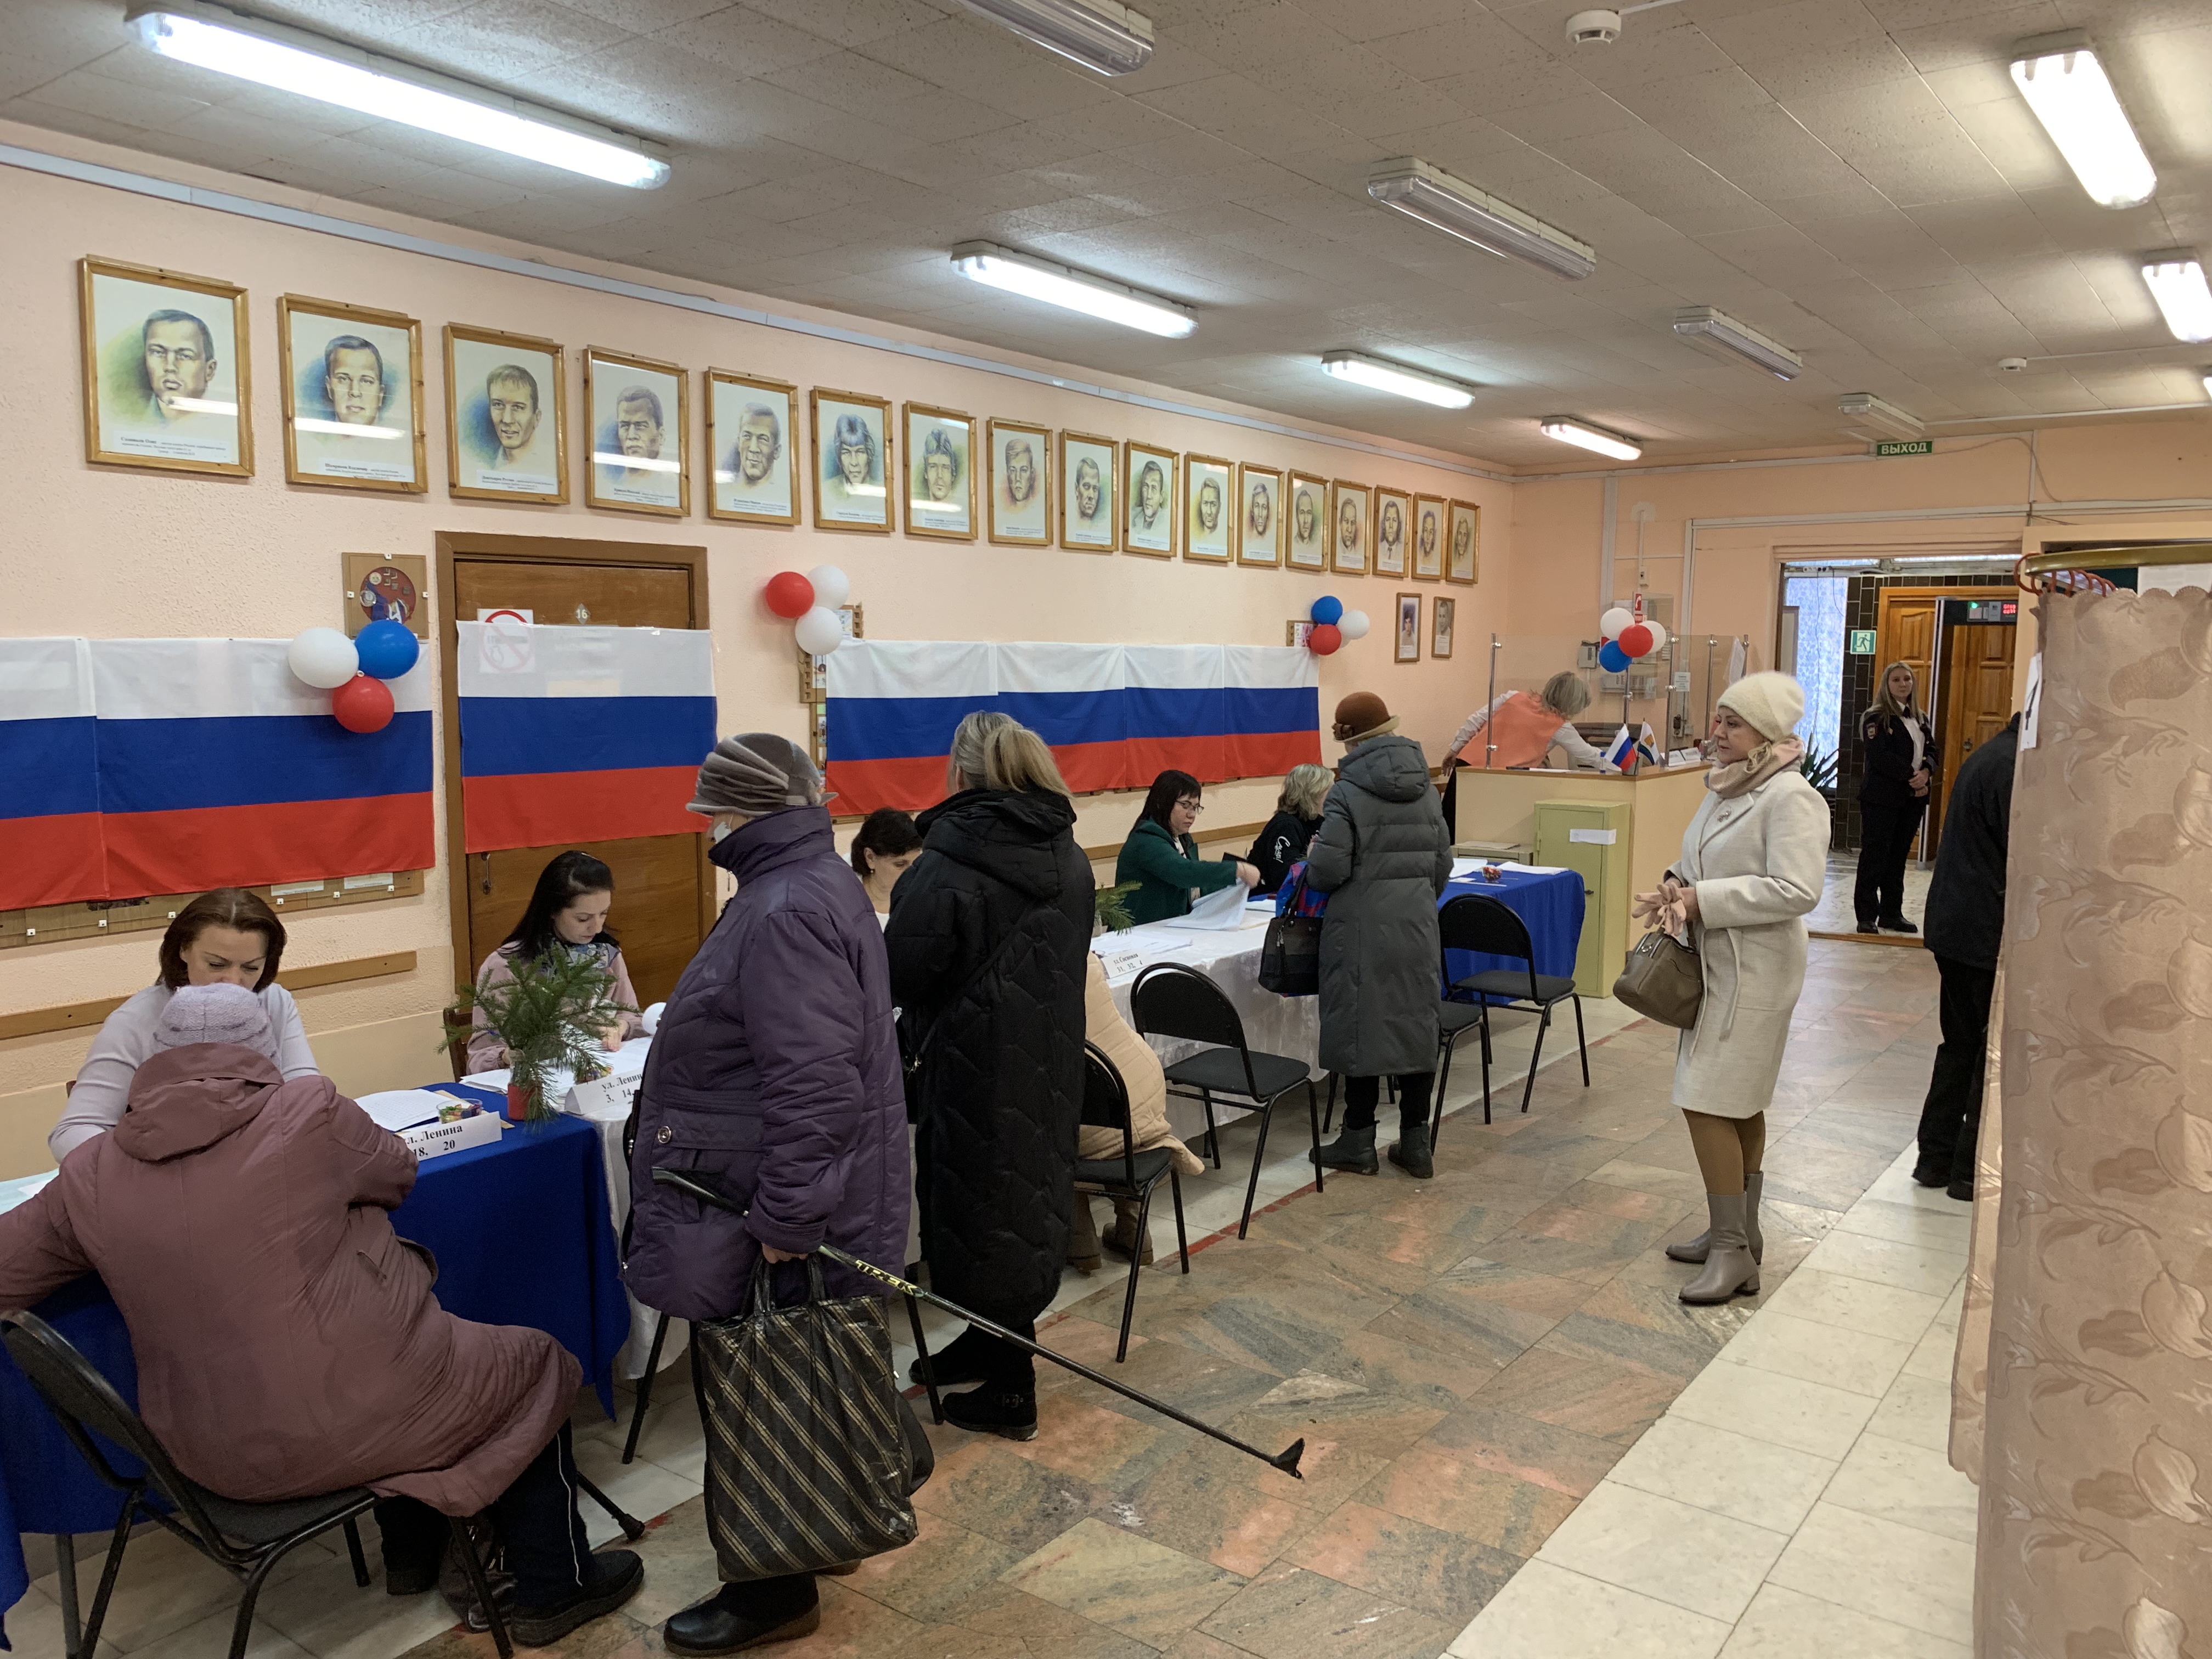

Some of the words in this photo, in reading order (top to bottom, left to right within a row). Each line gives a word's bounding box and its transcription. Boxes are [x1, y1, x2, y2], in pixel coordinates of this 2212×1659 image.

[1881, 442, 1928, 455] ВЫХОД
[575, 609, 588, 619] 16
[601, 1083, 615, 1092] ул.
[616, 1074, 643, 1086] Ленин
[421, 1125, 463, 1141] Ленина
[443, 1139, 455, 1151] 20
[855, 1259, 918, 1296] TREK
